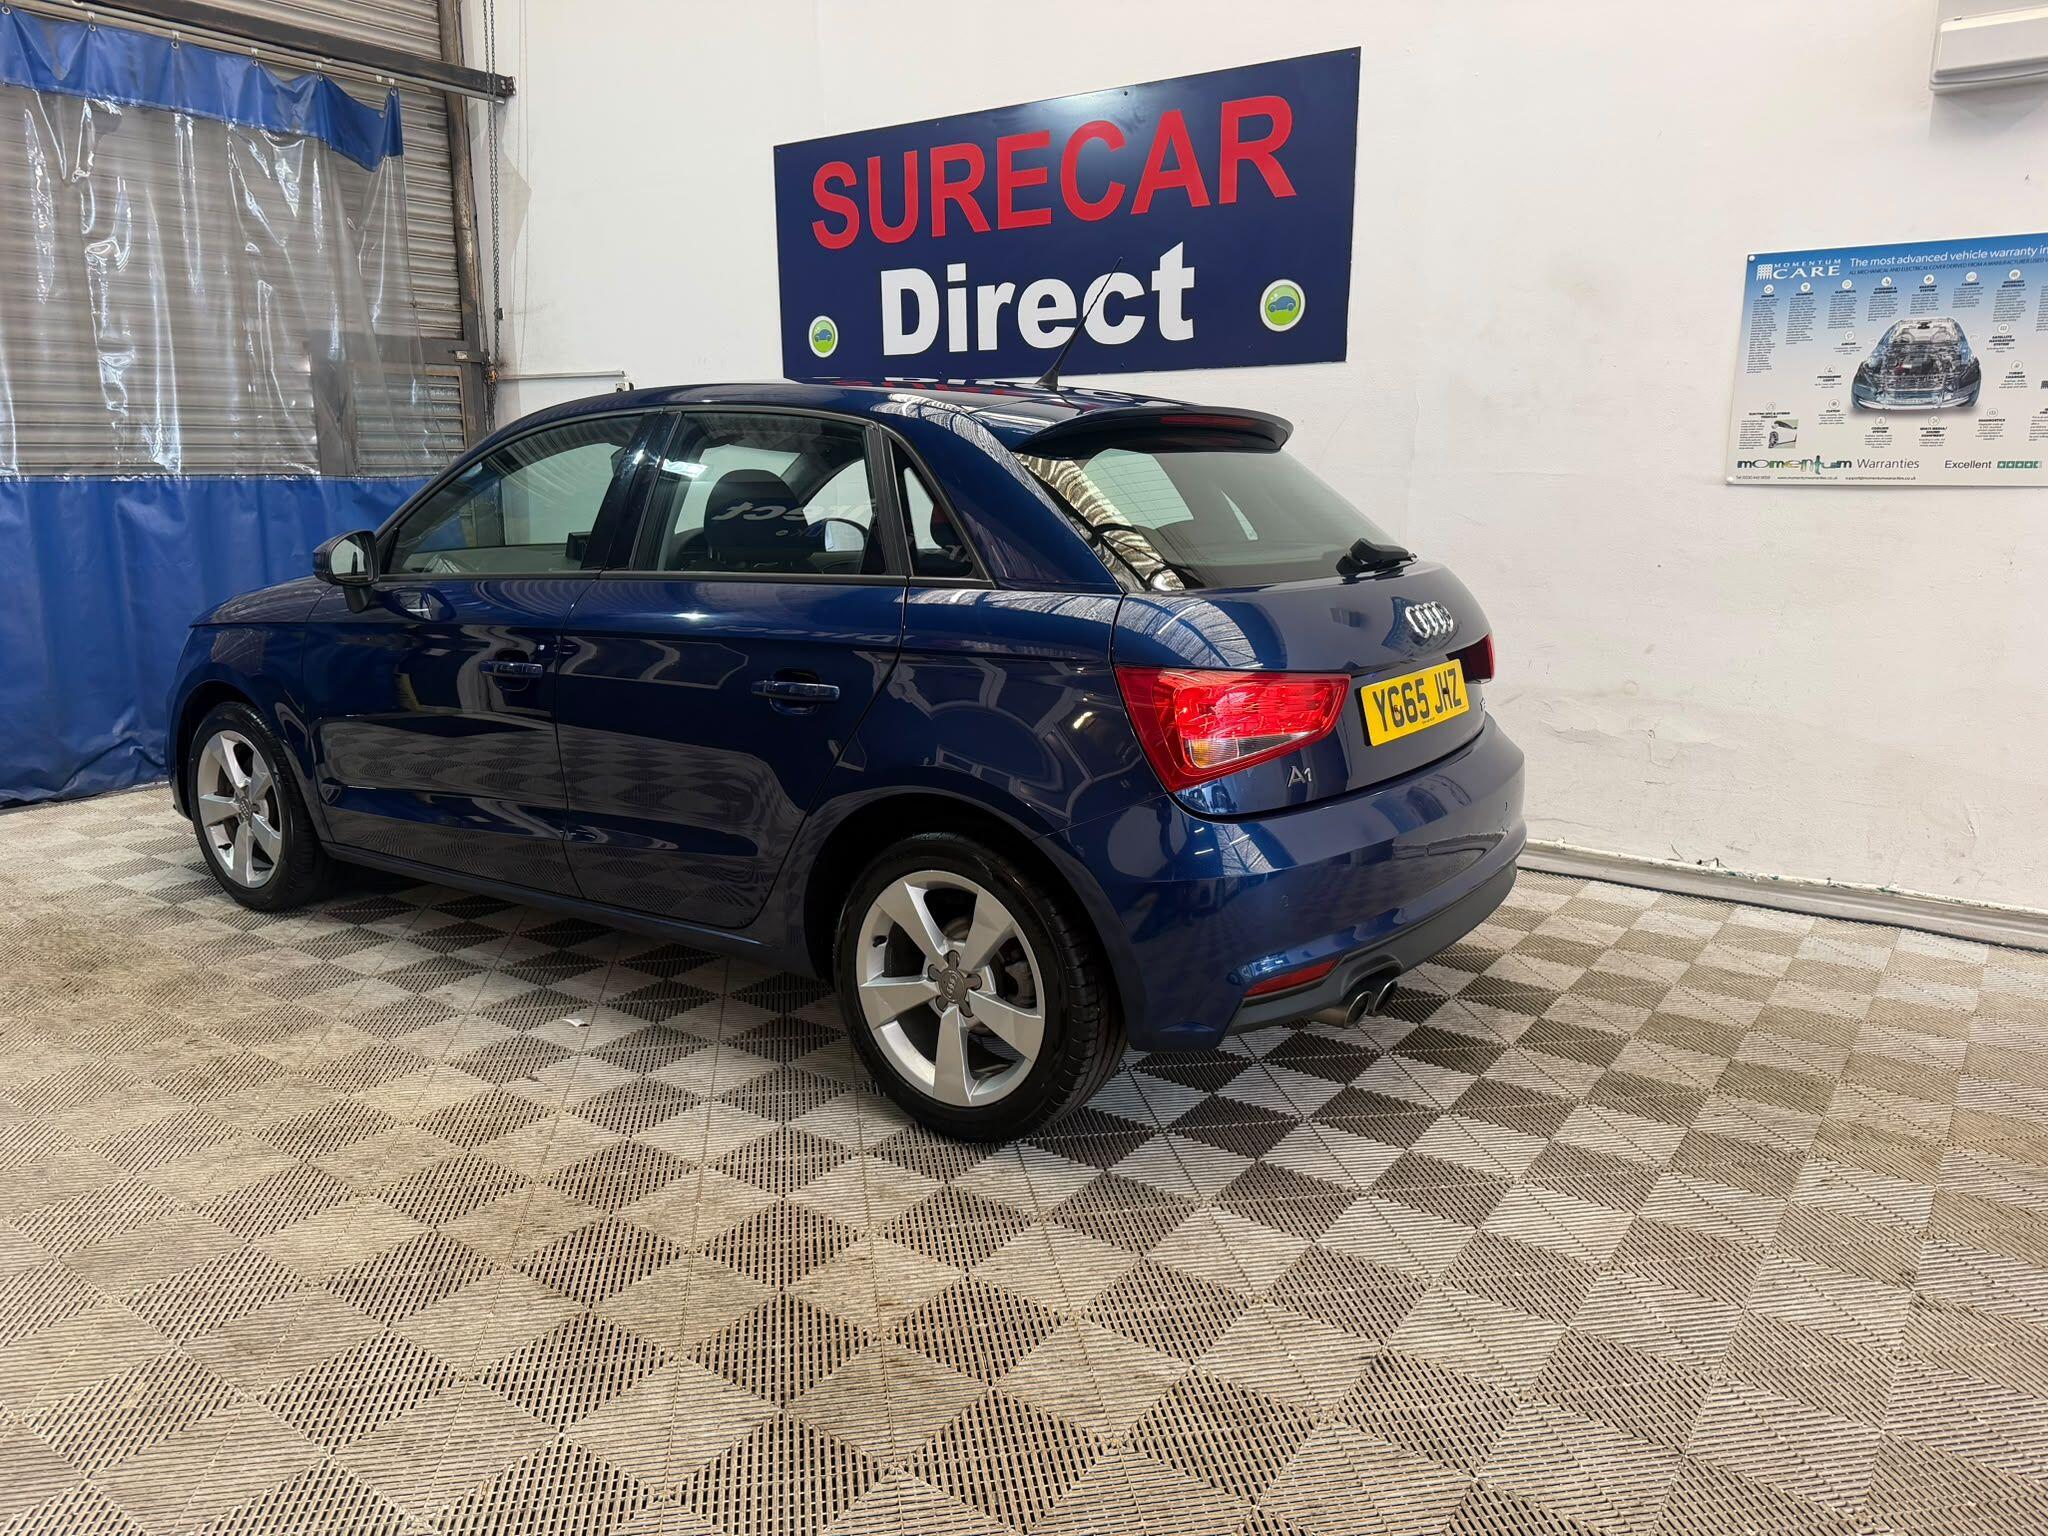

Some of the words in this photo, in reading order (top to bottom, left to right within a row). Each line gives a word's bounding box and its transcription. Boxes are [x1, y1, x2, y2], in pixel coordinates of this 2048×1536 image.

[811, 95, 1297, 250] SURECAR
[1773, 259, 1841, 268] MOMENTUM
[1850, 257, 1868, 267] The
[1870, 256, 1895, 266] most
[1896, 252, 1949, 264] advanced
[1950, 249, 1988, 261] vehicle
[1989, 245, 2039, 258] warranty
[1772, 265, 1841, 280] CARE
[880, 241, 1196, 357] Direct
[1737, 455, 1853, 475] momentum
[1856, 458, 1920, 469] Warranties
[1944, 459, 1992, 469] Excellent
[1434, 668, 1462, 714] JHZ
[1288, 766, 1313, 787] A1
